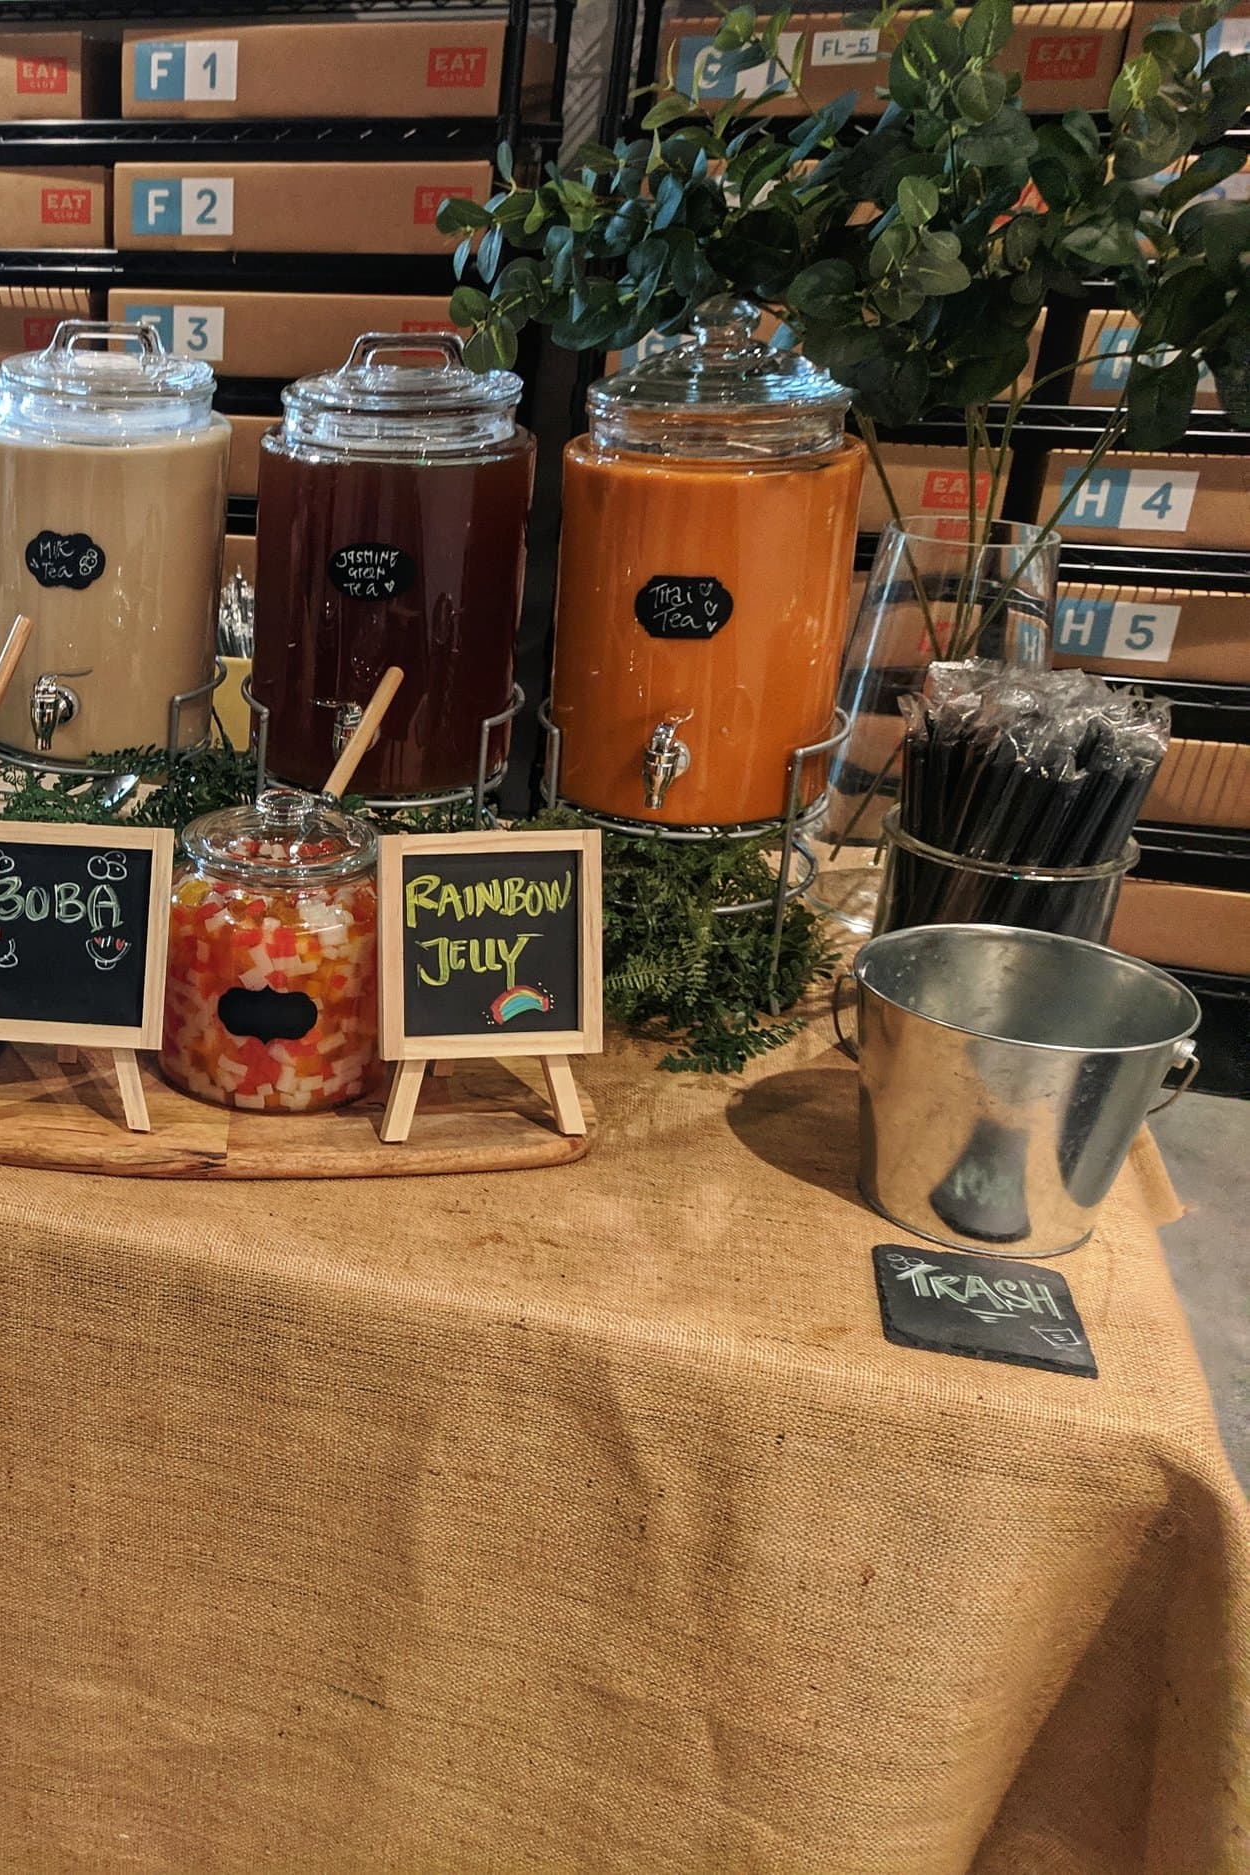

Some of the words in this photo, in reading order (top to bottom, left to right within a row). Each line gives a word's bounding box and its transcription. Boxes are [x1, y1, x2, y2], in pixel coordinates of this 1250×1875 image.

[822, 37, 870, 57] FL-5
[1075, 477, 1110, 518] H
[1141, 481, 1173, 519] 4
[1059, 608, 1094, 647] H
[1125, 614, 1157, 651] 5
[405, 870, 572, 929] RAINBOW
[415, 932, 538, 991] JELLY
[895, 1264, 1066, 1321] TRASH
